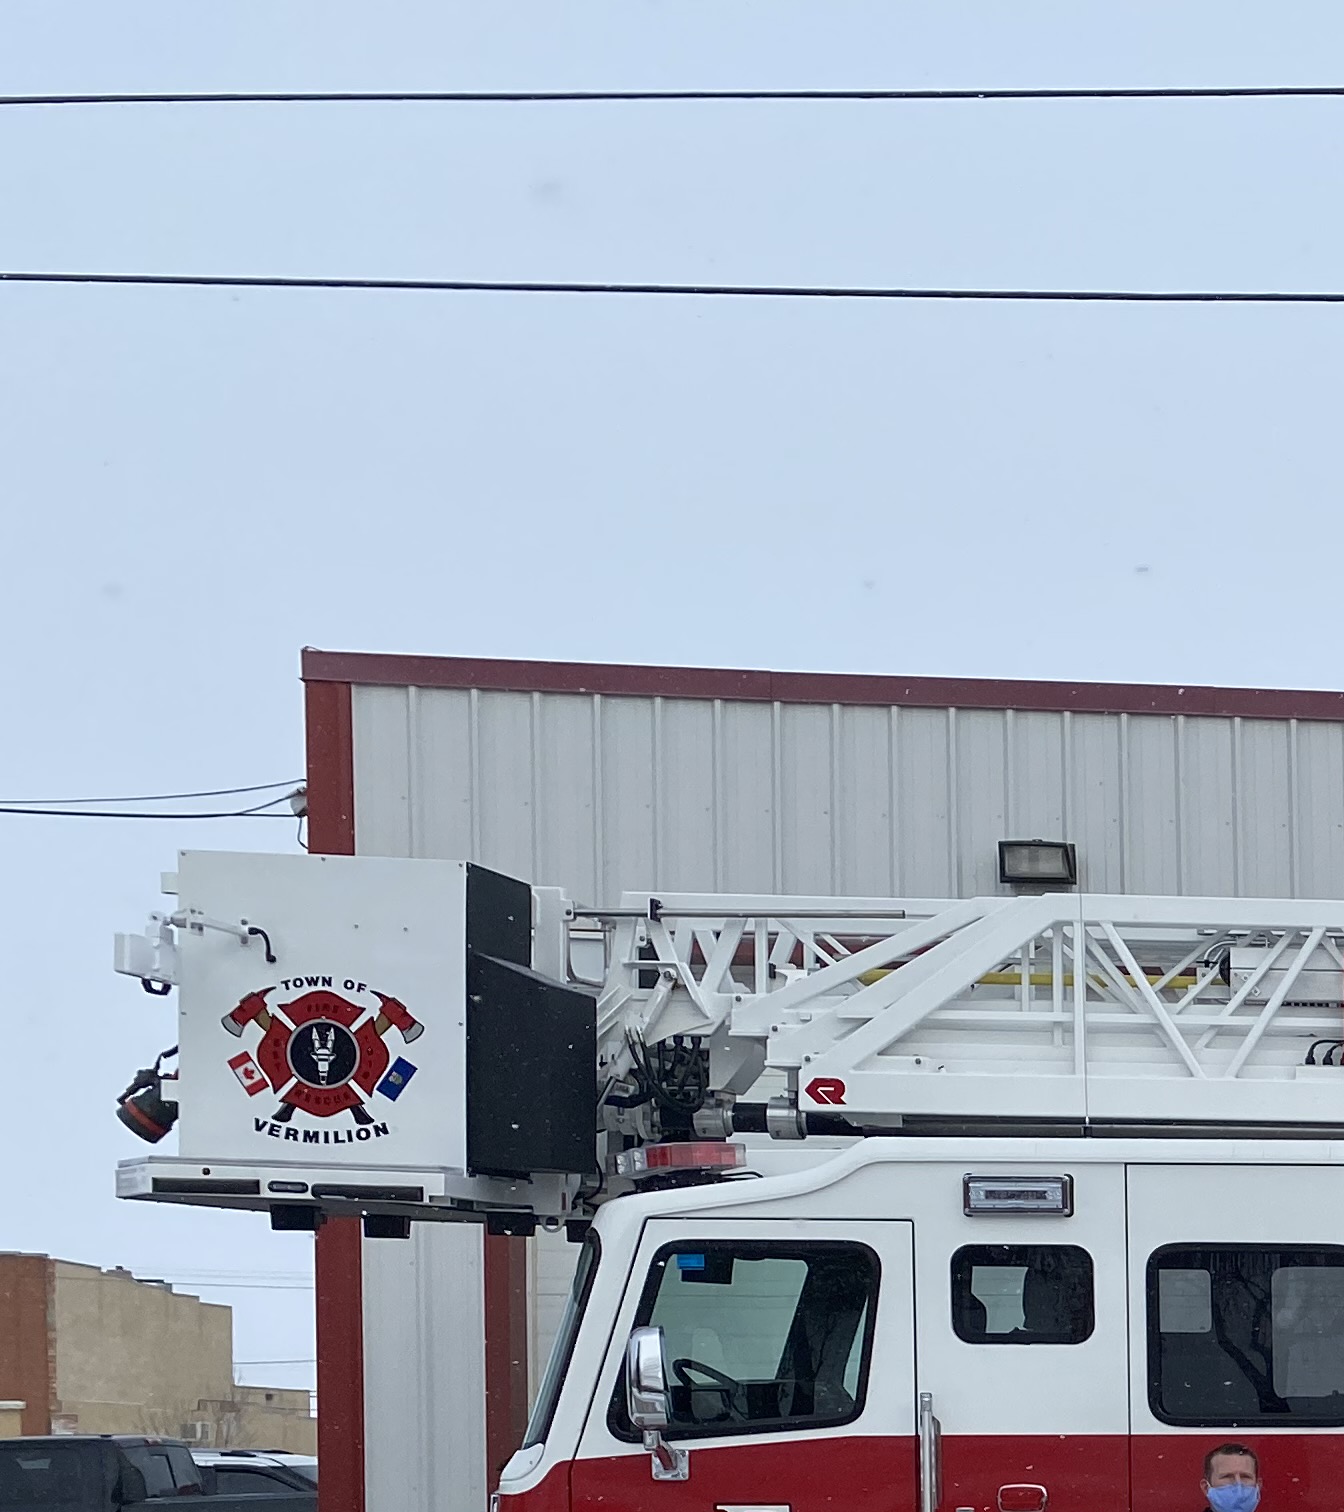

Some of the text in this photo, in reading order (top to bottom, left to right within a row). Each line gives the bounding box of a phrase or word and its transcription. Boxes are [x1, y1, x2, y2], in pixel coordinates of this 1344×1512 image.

[280, 975, 368, 993] TOWN OF
[254, 1117, 390, 1145] VERMILION
